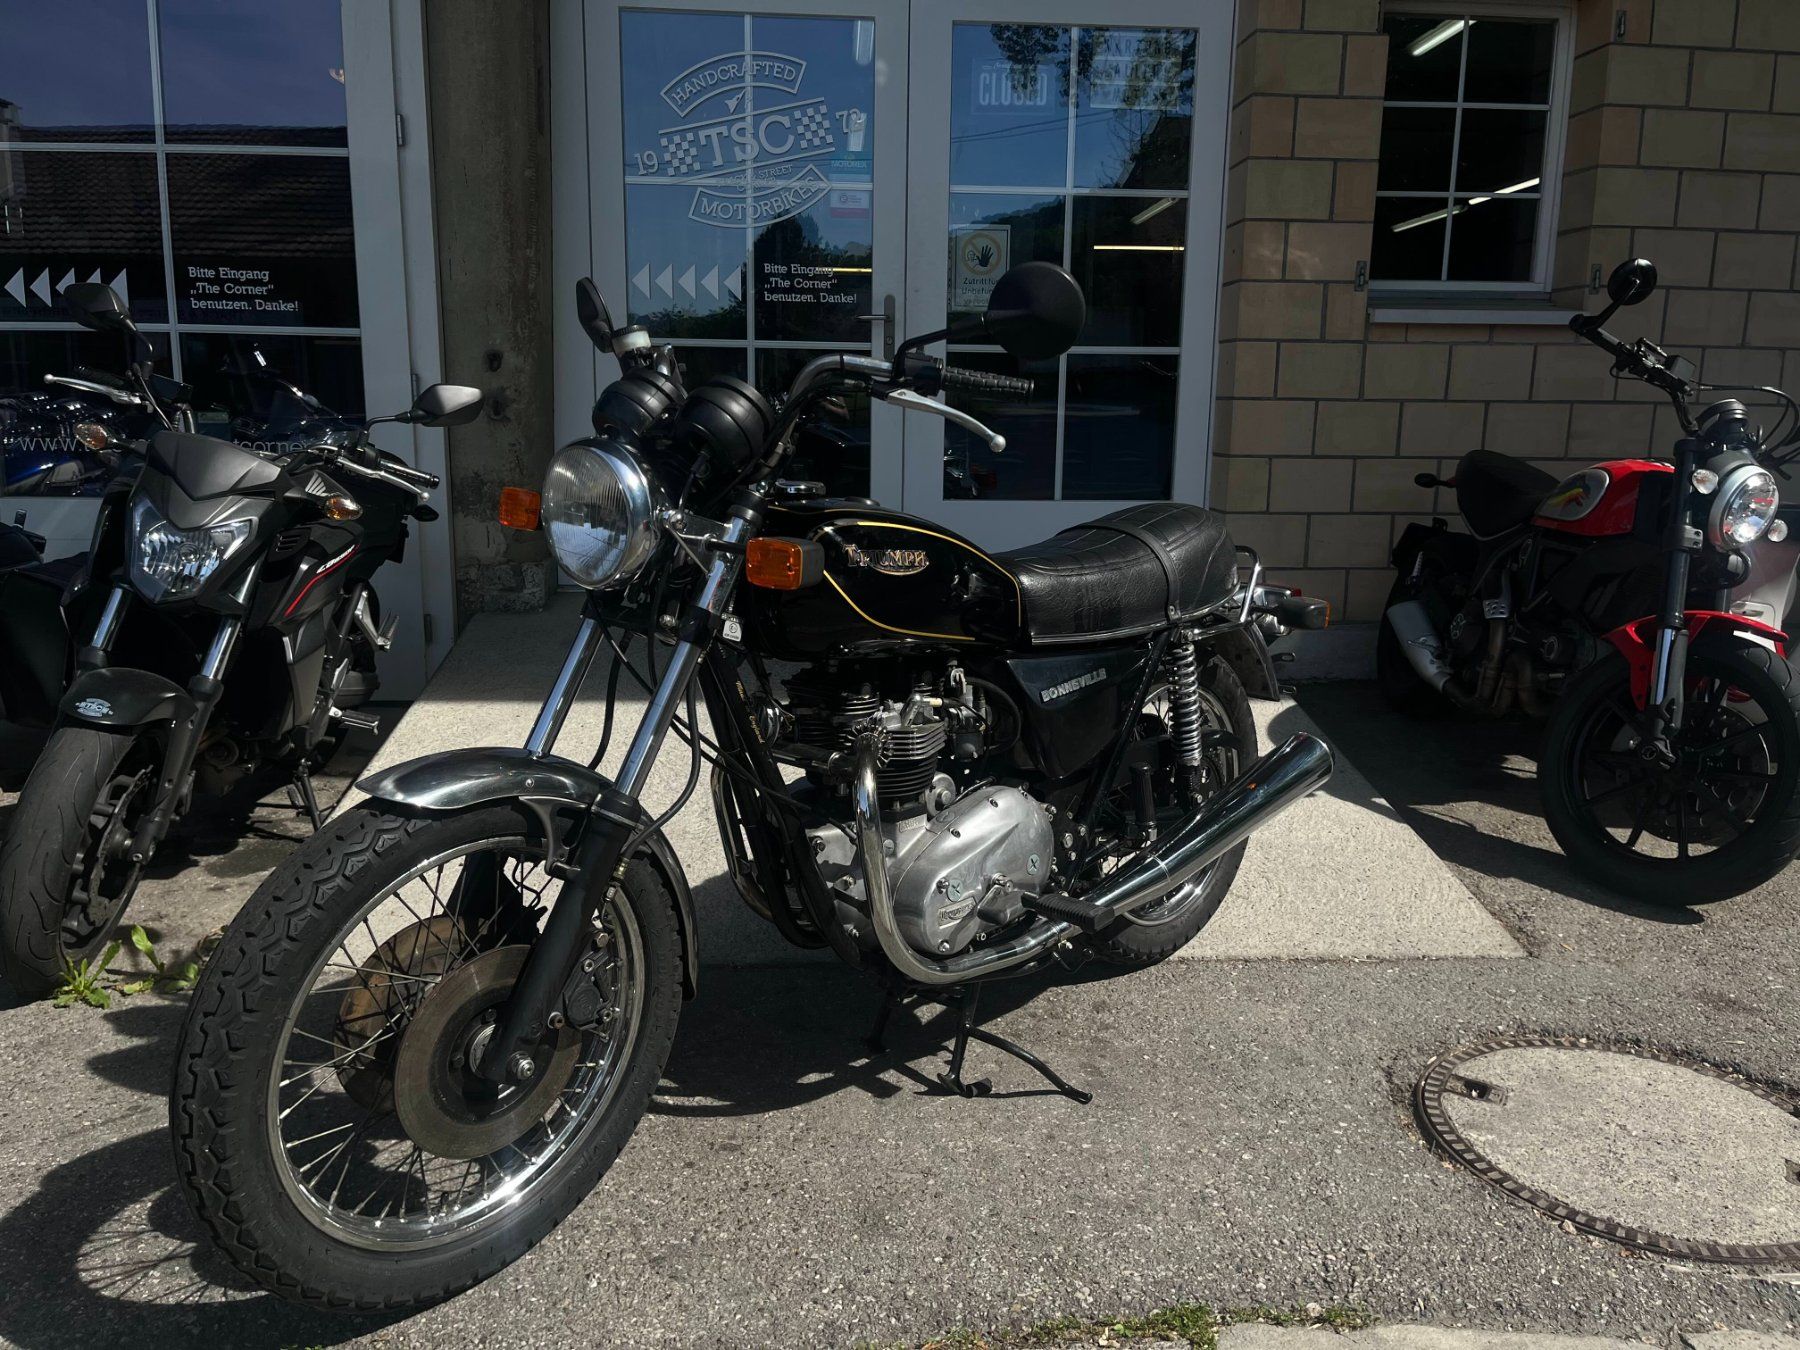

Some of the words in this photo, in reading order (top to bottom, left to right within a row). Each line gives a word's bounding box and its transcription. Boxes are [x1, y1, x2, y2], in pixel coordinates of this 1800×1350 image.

[672, 61, 796, 105] HANDCRAFTED
[634, 150, 659, 176] 19
[701, 115, 795, 168] TSC
[759, 164, 793, 178] STREET
[188, 266, 216, 278] Bitte
[219, 267, 270, 282] Eingang
[764, 263, 788, 274] Bitte
[791, 264, 834, 277] Eingang
[190, 297, 253, 310] benutzen.
[255, 299, 299, 312] Danke!
[764, 292, 817, 303] benutzen.
[820, 292, 857, 304] Danke!
[842, 544, 926, 567] TRIUMPH
[1041, 668, 1107, 702] BONNEVILLE
